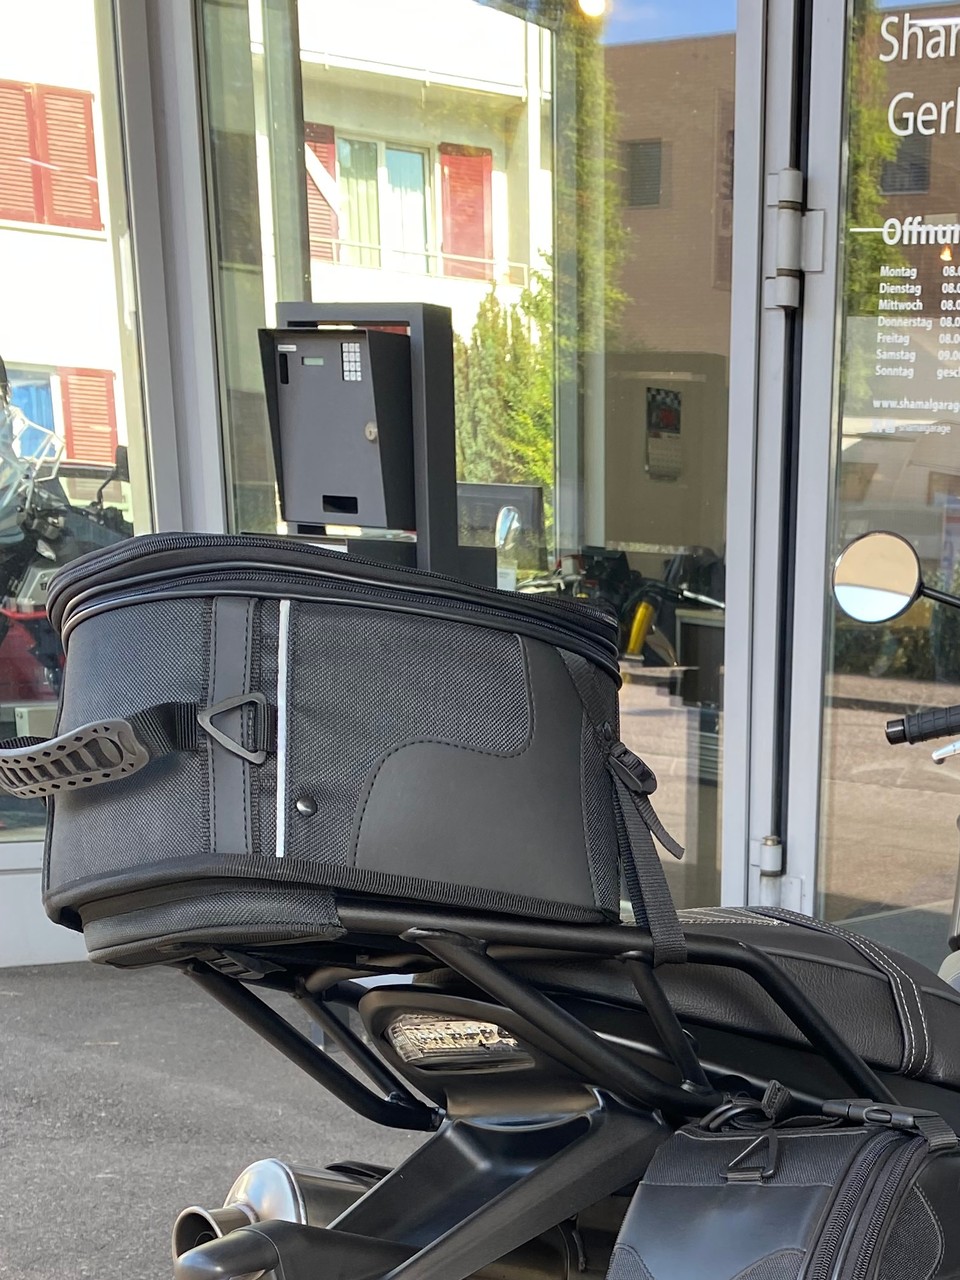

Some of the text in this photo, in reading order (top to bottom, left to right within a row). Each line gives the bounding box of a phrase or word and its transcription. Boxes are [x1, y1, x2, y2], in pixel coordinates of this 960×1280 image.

[880, 266, 917, 279] Montag
[879, 283, 922, 296] Dienstag
[878, 299, 923, 311] Mittwoch
[877, 316, 932, 330] Donnerstag
[877, 333, 910, 346] Freitag
[876, 349, 916, 362] Samstag
[875, 365, 914, 379] Sonntag
